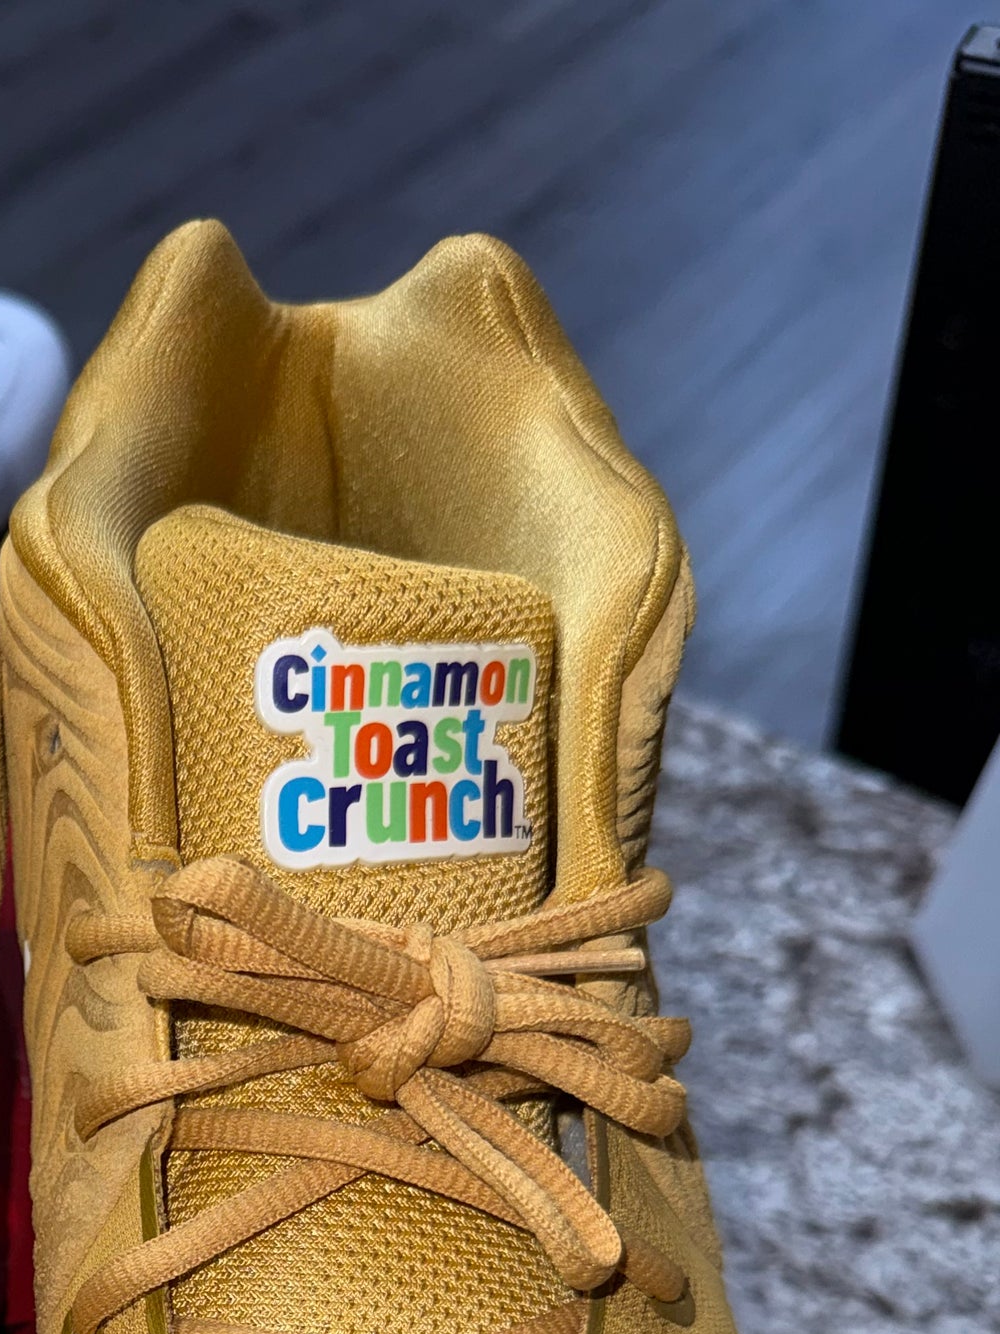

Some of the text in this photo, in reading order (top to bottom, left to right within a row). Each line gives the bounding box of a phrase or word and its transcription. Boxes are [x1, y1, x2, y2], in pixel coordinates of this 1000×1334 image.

[272, 644, 531, 714] Cinnamon
[324, 709, 485, 779] Toast
[278, 760, 514, 853] Crunch
